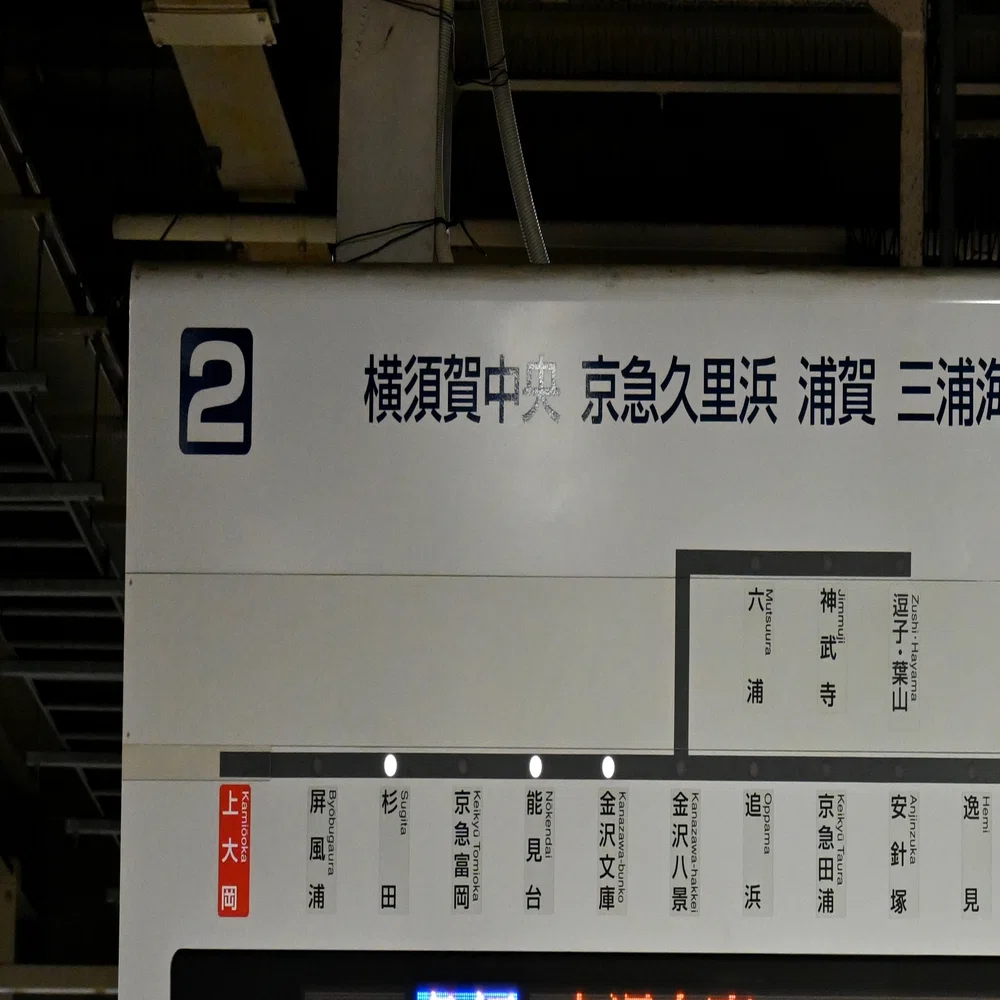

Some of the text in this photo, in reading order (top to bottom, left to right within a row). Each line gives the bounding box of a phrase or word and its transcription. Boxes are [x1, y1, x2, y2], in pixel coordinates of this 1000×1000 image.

[186, 340, 246, 443] 2
[364, 354, 562, 424] 横須賀中央
[582, 355, 777, 424] 京急久里浜
[798, 356, 875, 425] 浦賀
[747, 587, 764, 703] 六浦
[765, 589, 773, 655] Mutsuura
[820, 588, 837, 707] 神武寺
[836, 589, 845, 643] Jimmuji
[221, 789, 238, 911] 上大岡
[309, 790, 326, 909] 屏風浦
[381, 790, 397, 909] 杉田
[399, 791, 408, 835] Sugita
[454, 790, 470, 909] 京急富岡
[526, 790, 542, 910] 能見台
[599, 791, 616, 910] 金沢文庫
[618, 792, 626, 903] Kanazawa-bunko
[672, 792, 688, 911] 金沢八景
[691, 793, 699, 912] Kanazawa-hakkei
[745, 793, 761, 909] 追浜
[763, 793, 772, 854] Oppama
[818, 794, 834, 913] 京急田浦
[891, 794, 907, 914] 安針塚
[908, 795, 917, 864] Anjinzuka
[964, 795, 979, 912] 逸見
